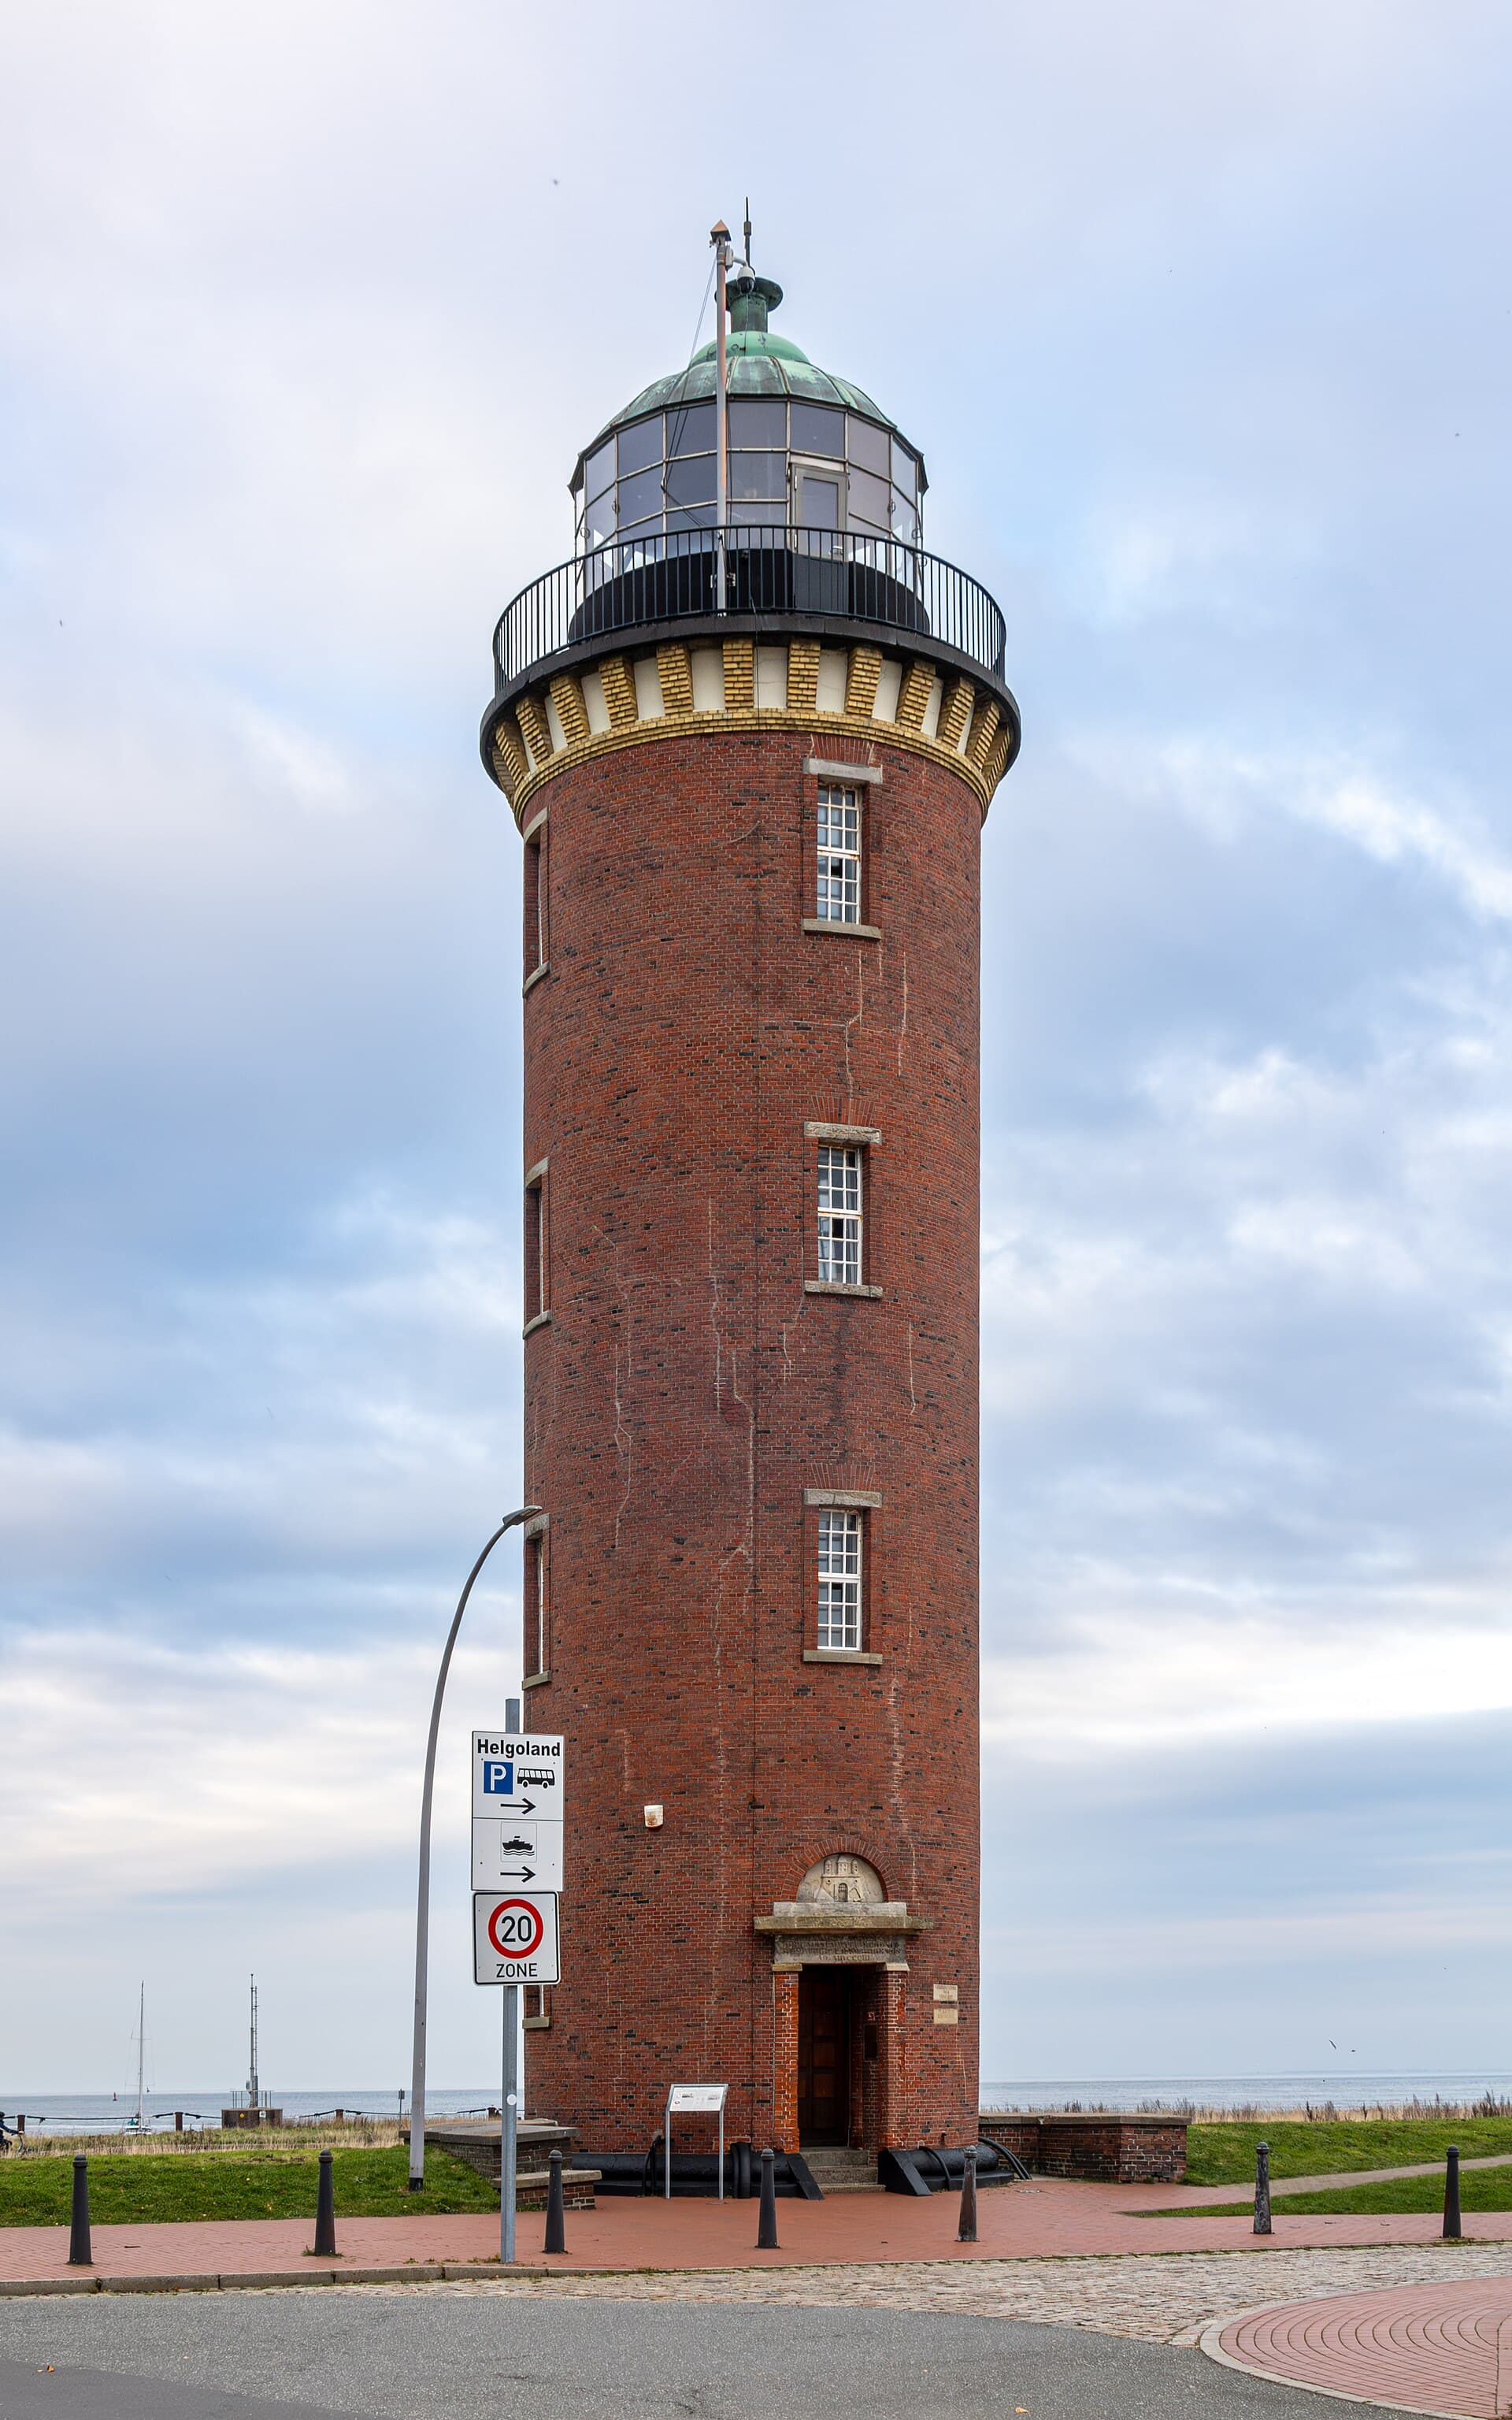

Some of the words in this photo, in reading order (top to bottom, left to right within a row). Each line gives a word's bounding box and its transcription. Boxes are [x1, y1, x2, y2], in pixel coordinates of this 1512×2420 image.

[478, 1739, 561, 1758] Helgoland
[491, 1765, 506, 1791] P
[502, 1916, 532, 1943] 20
[497, 1964, 538, 1978] ZONE
